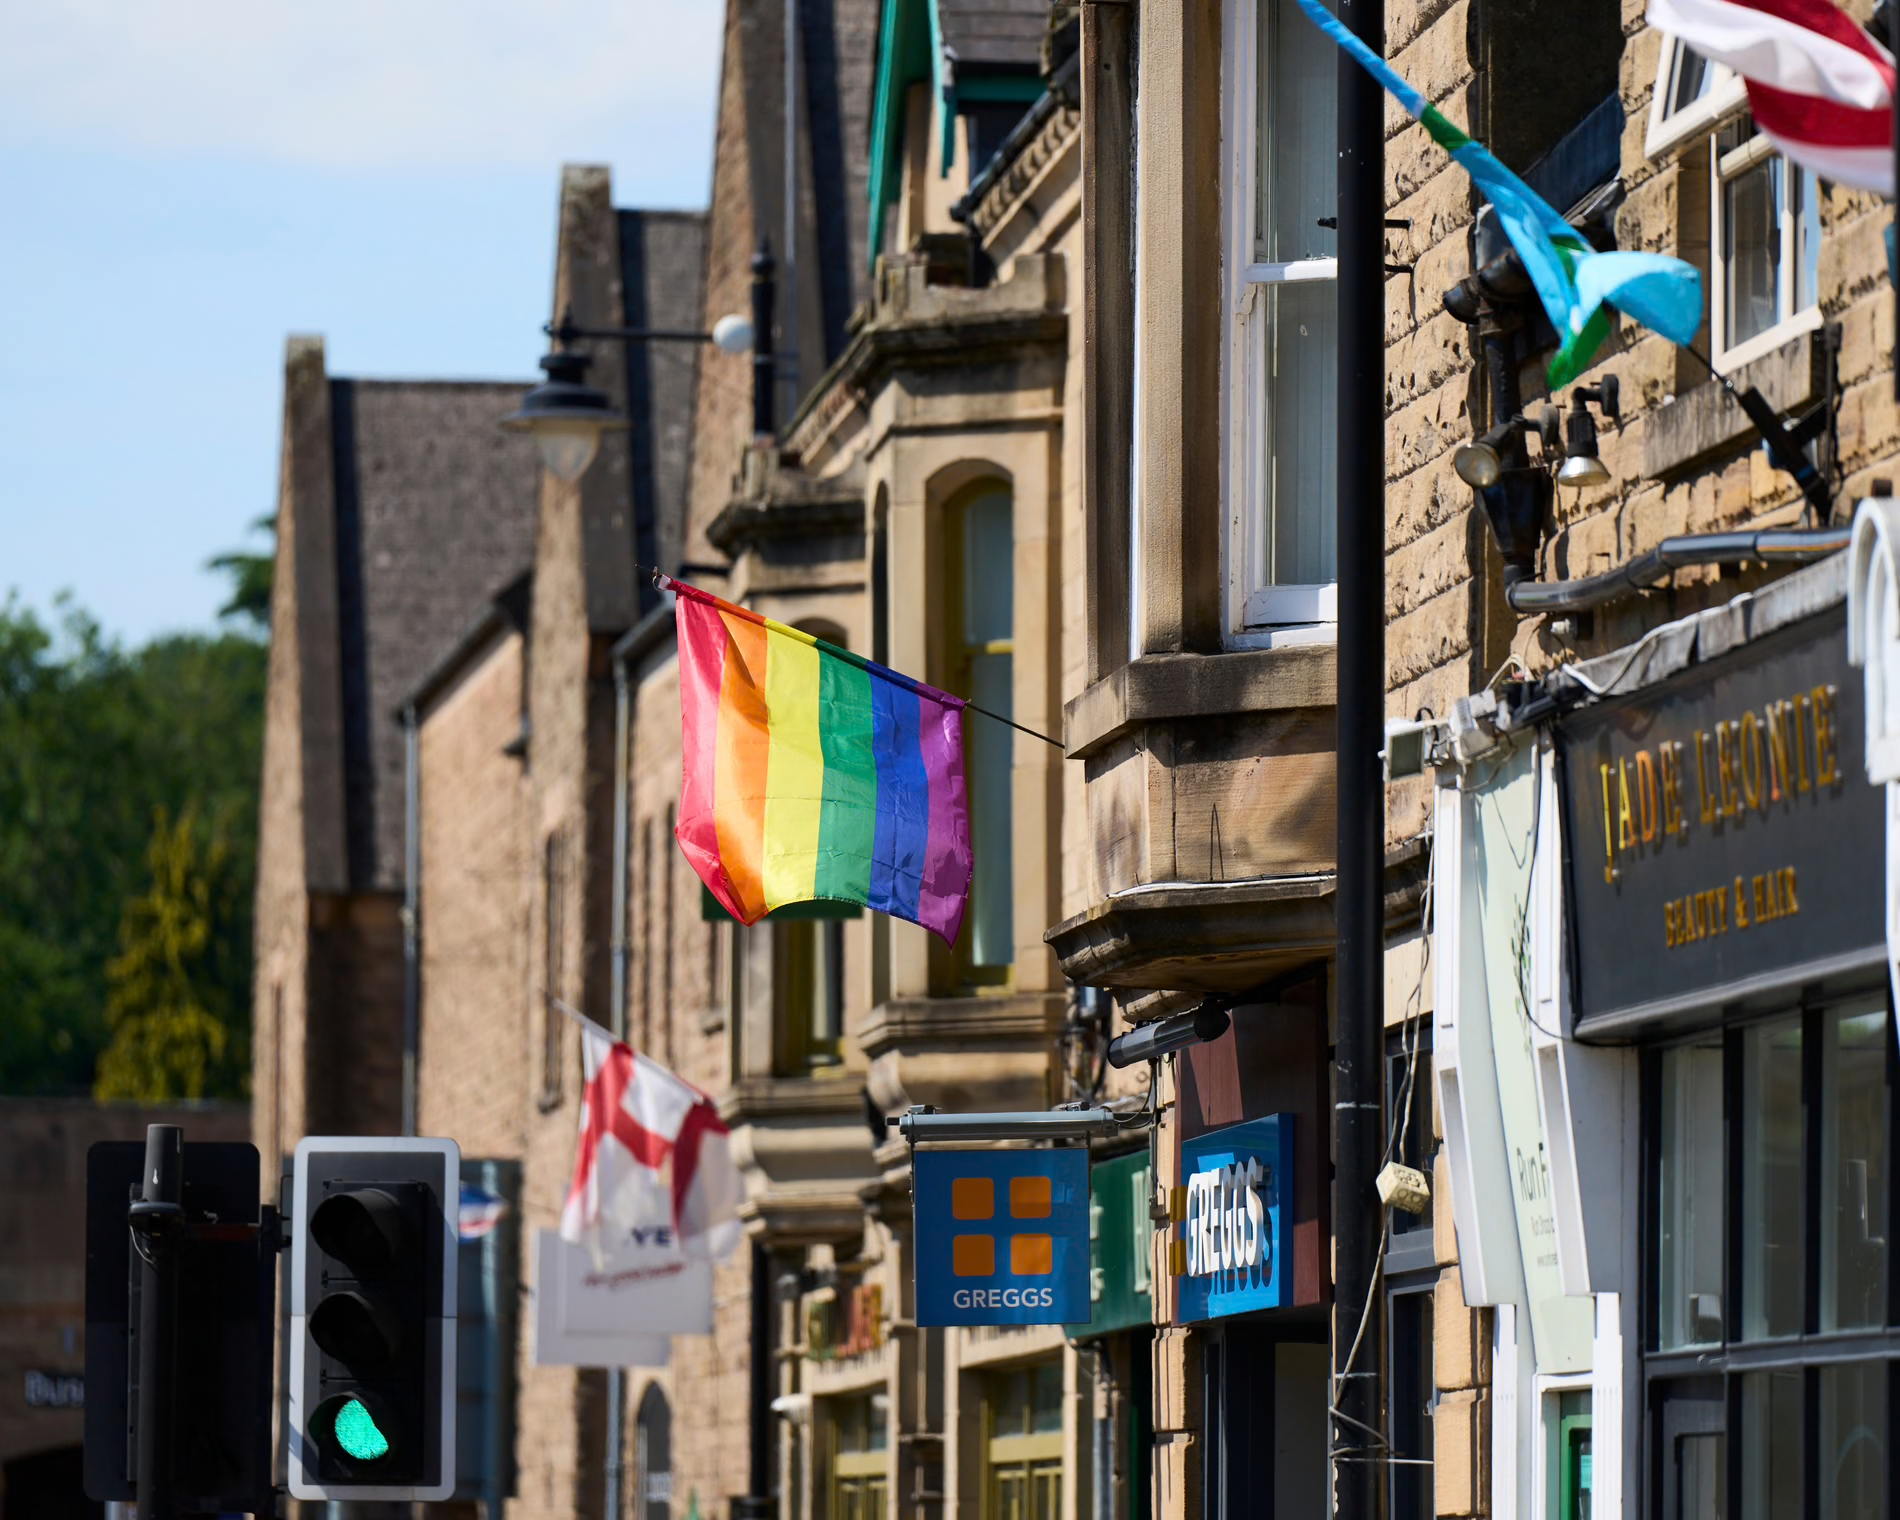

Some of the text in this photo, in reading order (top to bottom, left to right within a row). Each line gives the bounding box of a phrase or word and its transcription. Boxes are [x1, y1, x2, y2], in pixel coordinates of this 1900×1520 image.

[1600, 684, 1838, 884] JADE LEONIE
[1664, 866, 1799, 947] BEAUTY & HAIR
[1516, 1147, 1541, 1201] Run
[1186, 1155, 1264, 1277] GREGGS
[953, 1287, 1053, 1309] GREGGS
